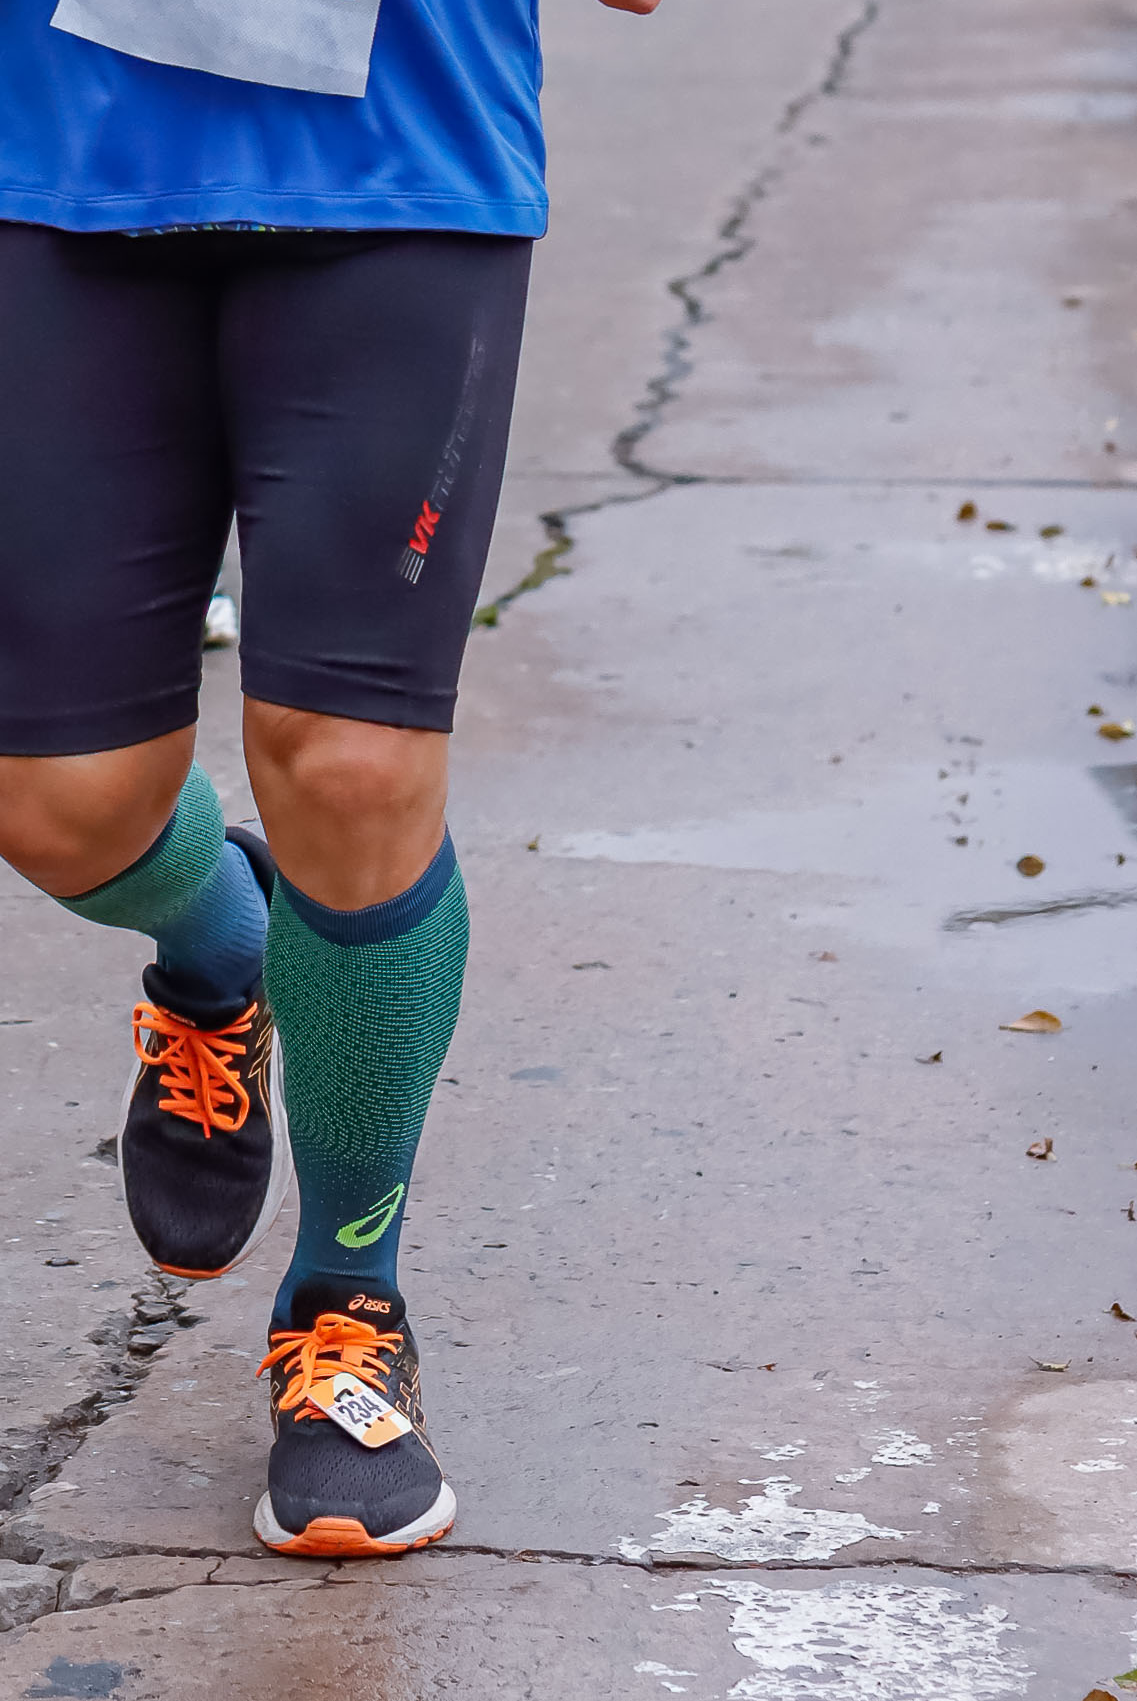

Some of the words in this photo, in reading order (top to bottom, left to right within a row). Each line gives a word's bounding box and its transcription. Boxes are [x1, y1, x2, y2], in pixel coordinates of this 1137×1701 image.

[409, 500, 441, 554] VK
[363, 1299, 392, 1314] asics
[337, 1395, 383, 1425] 234
